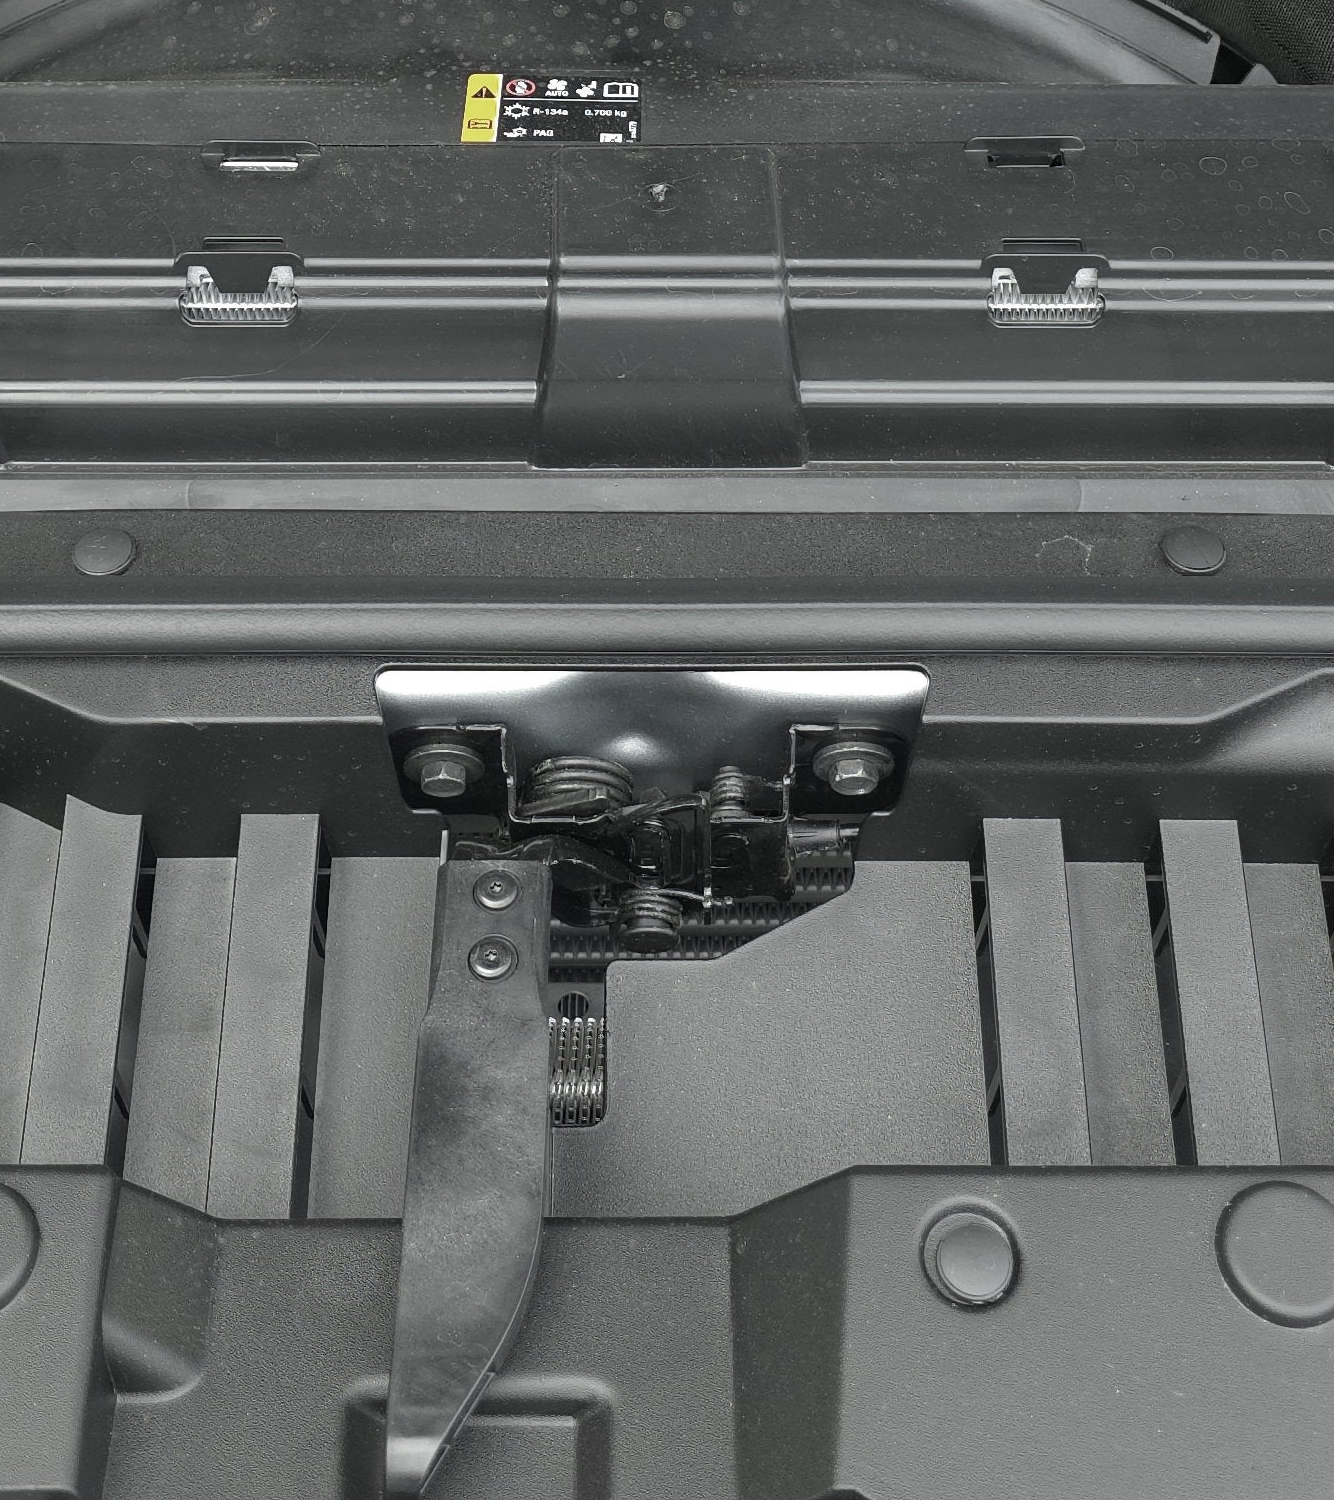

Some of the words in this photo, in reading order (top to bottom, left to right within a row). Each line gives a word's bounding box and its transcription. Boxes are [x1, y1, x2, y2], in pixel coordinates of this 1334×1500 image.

[532, 107, 569, 116] R-134a
[614, 109, 628, 118] kg
[533, 129, 554, 137] PAG
